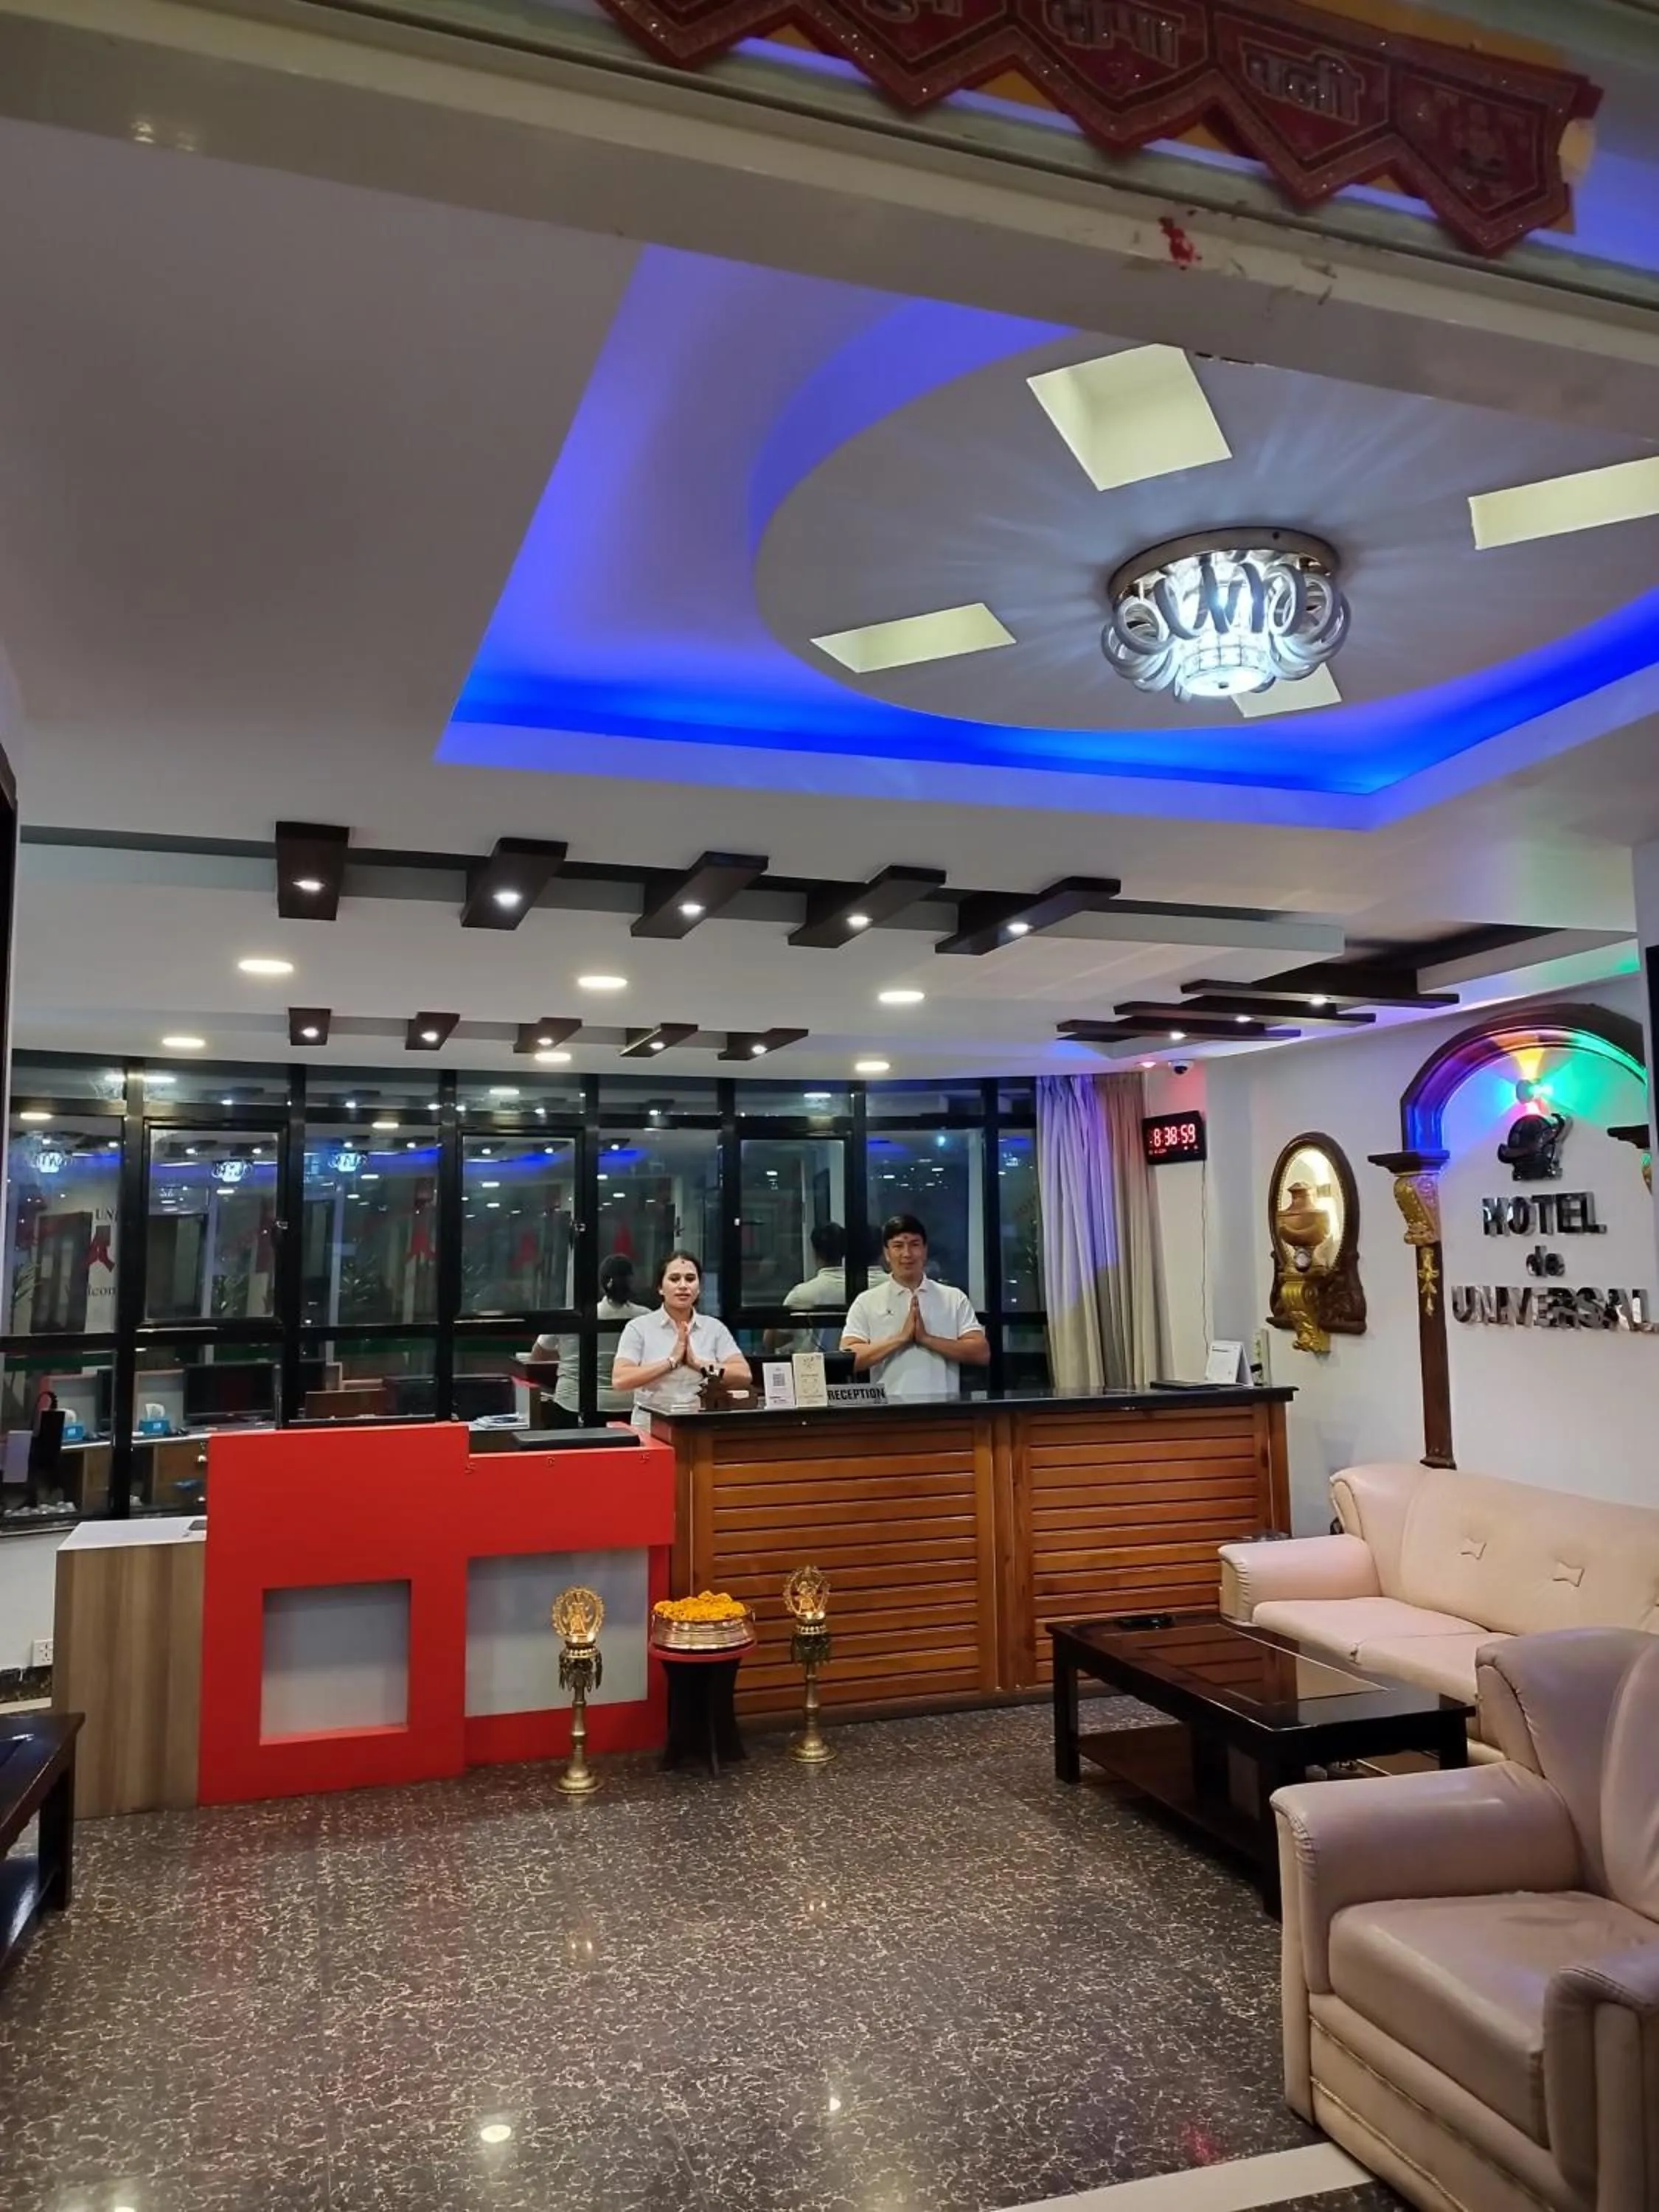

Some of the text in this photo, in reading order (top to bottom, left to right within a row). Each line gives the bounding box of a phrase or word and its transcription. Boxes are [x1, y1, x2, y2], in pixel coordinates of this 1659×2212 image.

[1482, 1192, 1607, 1236] HOTEL
[1526, 1245, 1565, 1276] de
[1450, 1284, 1659, 1334] UNIVERSAL
[827, 1388, 886, 1400] RECEPTION
